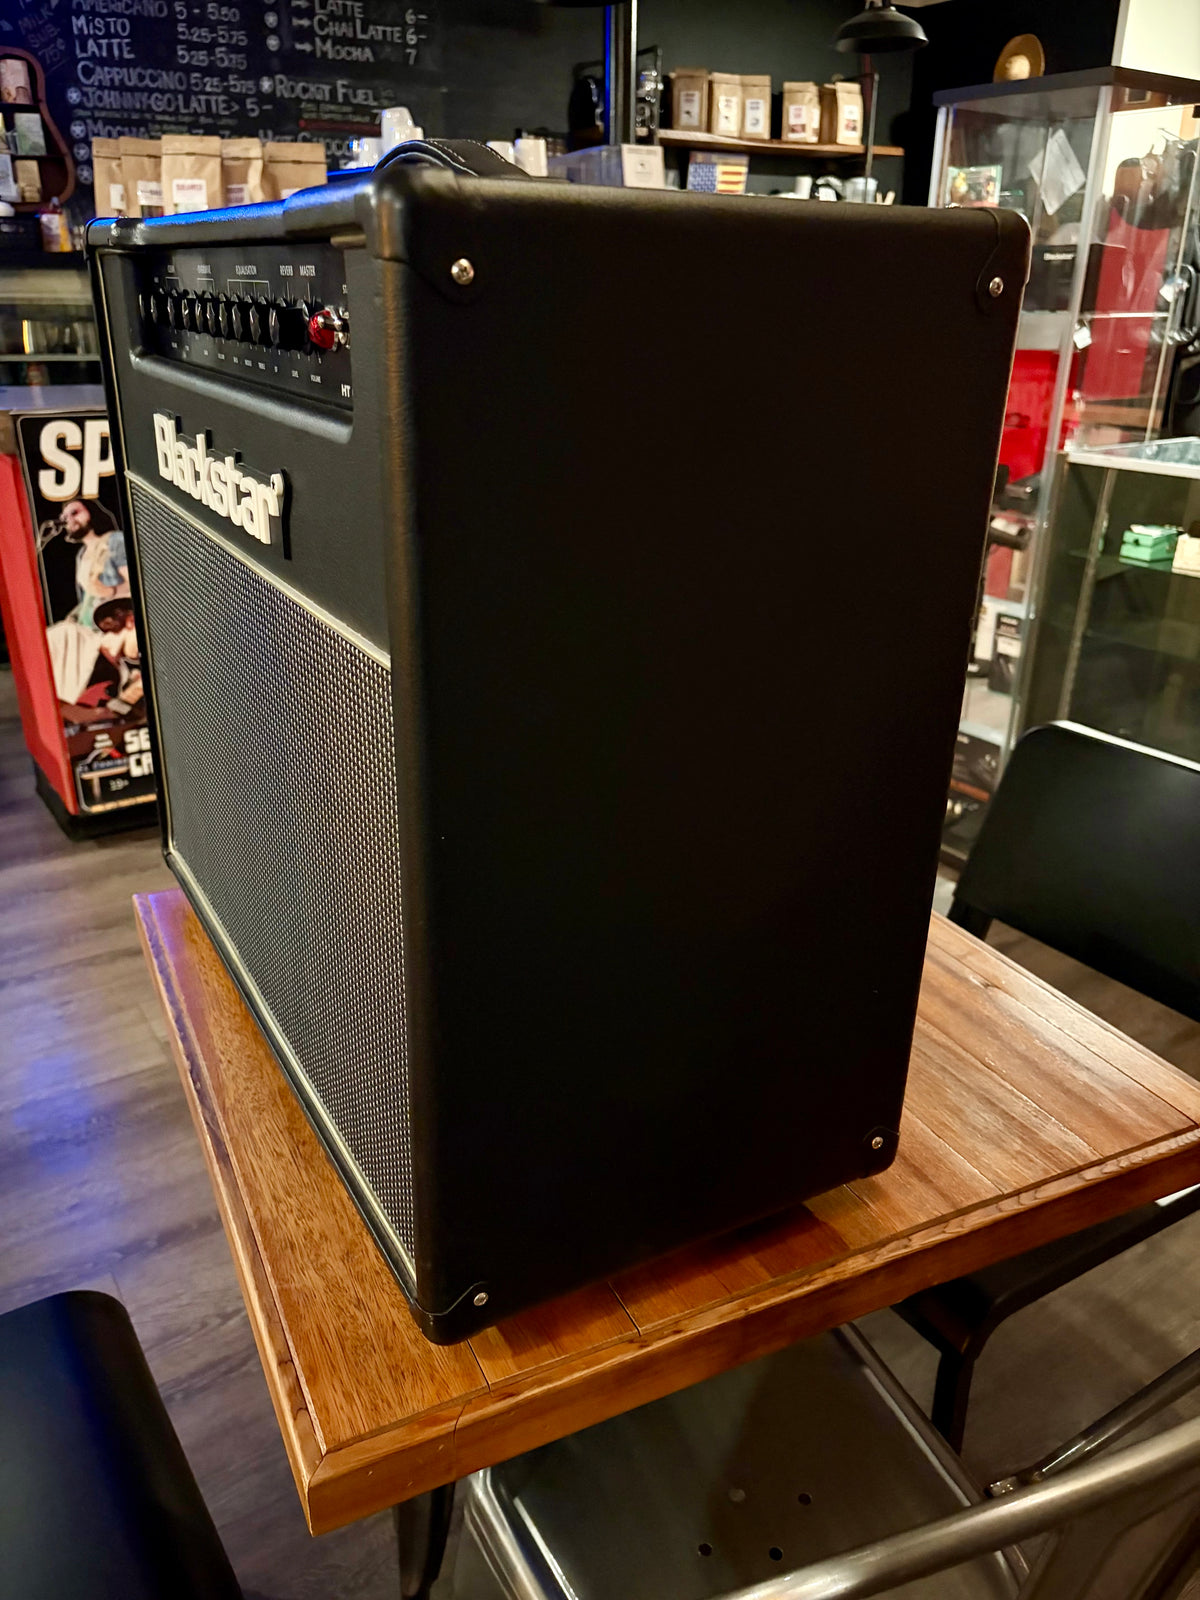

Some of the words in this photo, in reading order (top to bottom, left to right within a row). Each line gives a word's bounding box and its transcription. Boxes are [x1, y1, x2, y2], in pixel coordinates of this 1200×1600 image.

[355, 18, 402, 43] LATTE
[75, 39, 135, 60] LATTE
[314, 37, 375, 62] MOCHA
[336, 79, 379, 106] FUEL
[299, 265, 316, 277] MASTER
[153, 413, 284, 545] Blackstar
